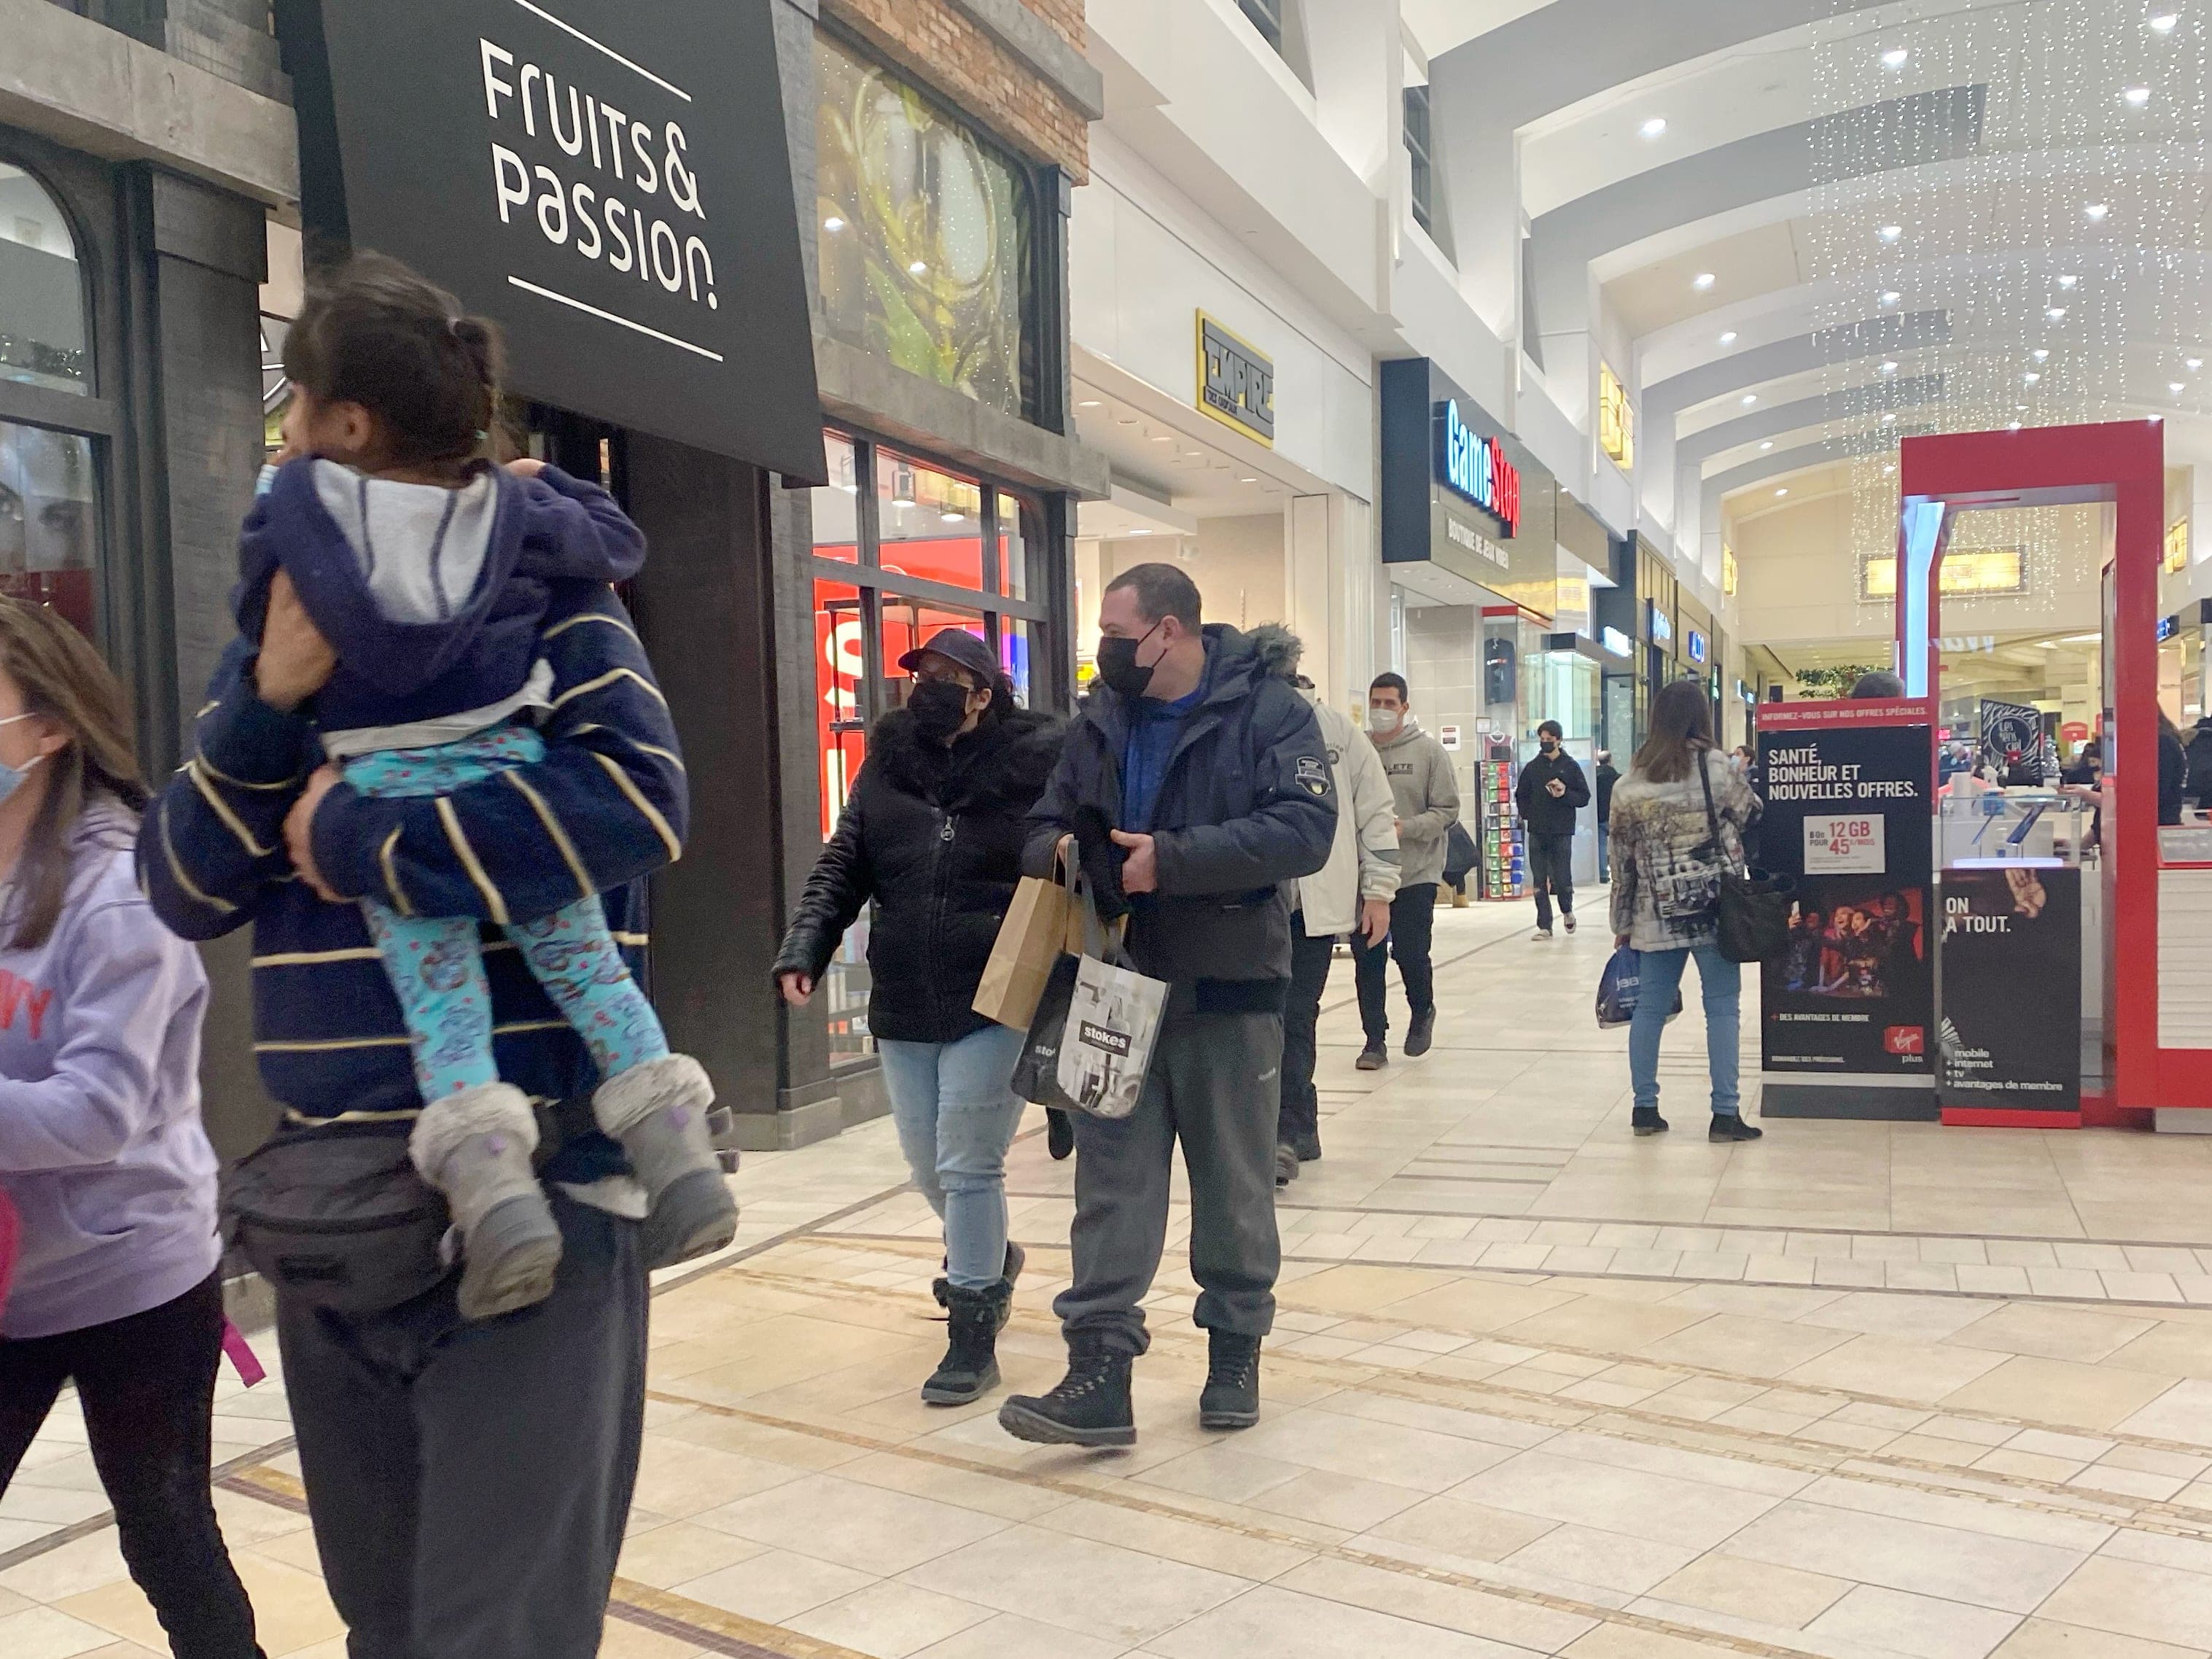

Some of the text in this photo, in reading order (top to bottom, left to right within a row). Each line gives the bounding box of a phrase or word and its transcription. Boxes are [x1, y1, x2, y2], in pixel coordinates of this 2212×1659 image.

[1203, 335, 1273, 424] EMPIRE
[1447, 398, 1520, 538] GameStop
[1761, 712, 1820, 720] INFORMEZ-VOUS
[1823, 710, 1838, 718] SUR
[1840, 710, 1855, 718] NOS
[1856, 708, 1884, 717] OFFRES
[1769, 743, 1821, 766] SANTÉ,
[1769, 764, 1861, 782] BONHEUR ET
[1769, 781, 1918, 800] NOUVELLES OFFRES.
[1829, 822, 1845, 837] 12
[1849, 821, 1870, 837] GB
[1829, 839, 1850, 855] 45
[1946, 897, 1968, 914] ON
[1946, 915, 2011, 933] A TOUT.
[1084, 1025, 1126, 1049] stokes
[1902, 1054, 1923, 1064] plus
[1955, 1049, 1989, 1057] mobile
[1955, 1060, 1993, 1068] internet
[1954, 1081, 2003, 1090] avantages
[2006, 1080, 2018, 1089] de
[2020, 1081, 2063, 1090] membre
